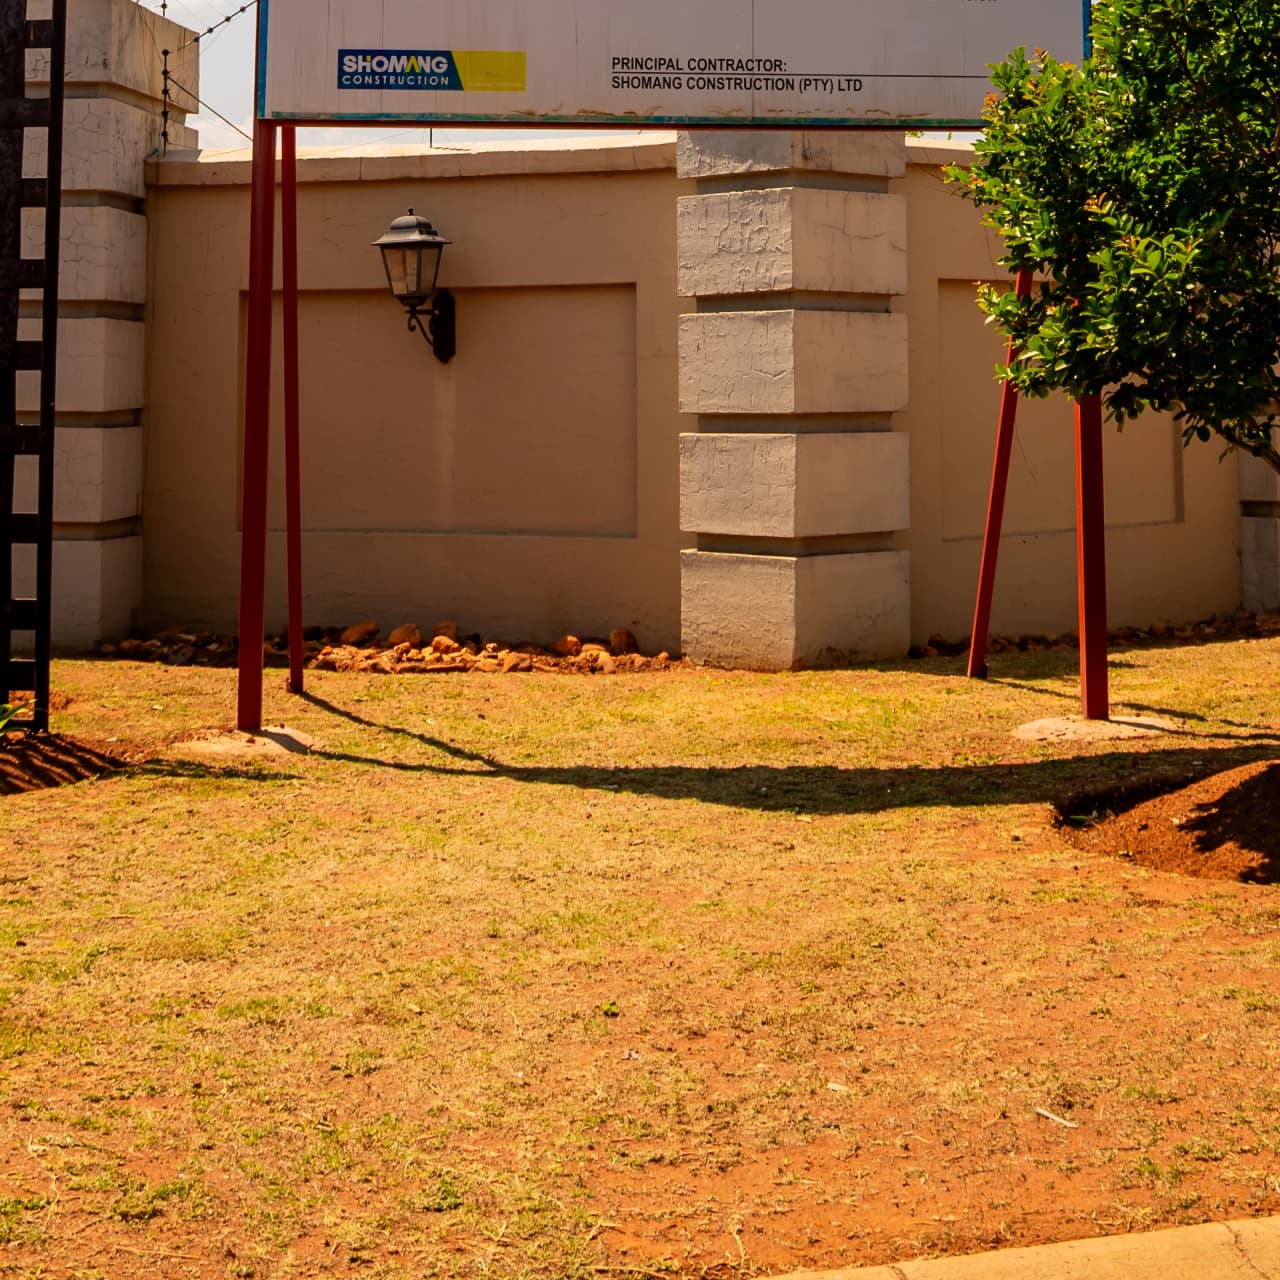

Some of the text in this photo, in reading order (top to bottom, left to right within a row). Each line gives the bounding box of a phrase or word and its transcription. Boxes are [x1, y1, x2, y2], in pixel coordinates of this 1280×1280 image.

[343, 56, 449, 73] SHOMANG
[612, 57, 786, 72] PRINCIPAL CONTRACTOR:
[342, 76, 449, 85] CONSTRUCTION
[612, 76, 862, 94] SHOMANG CONSTRUCTION (PTY) LTD
